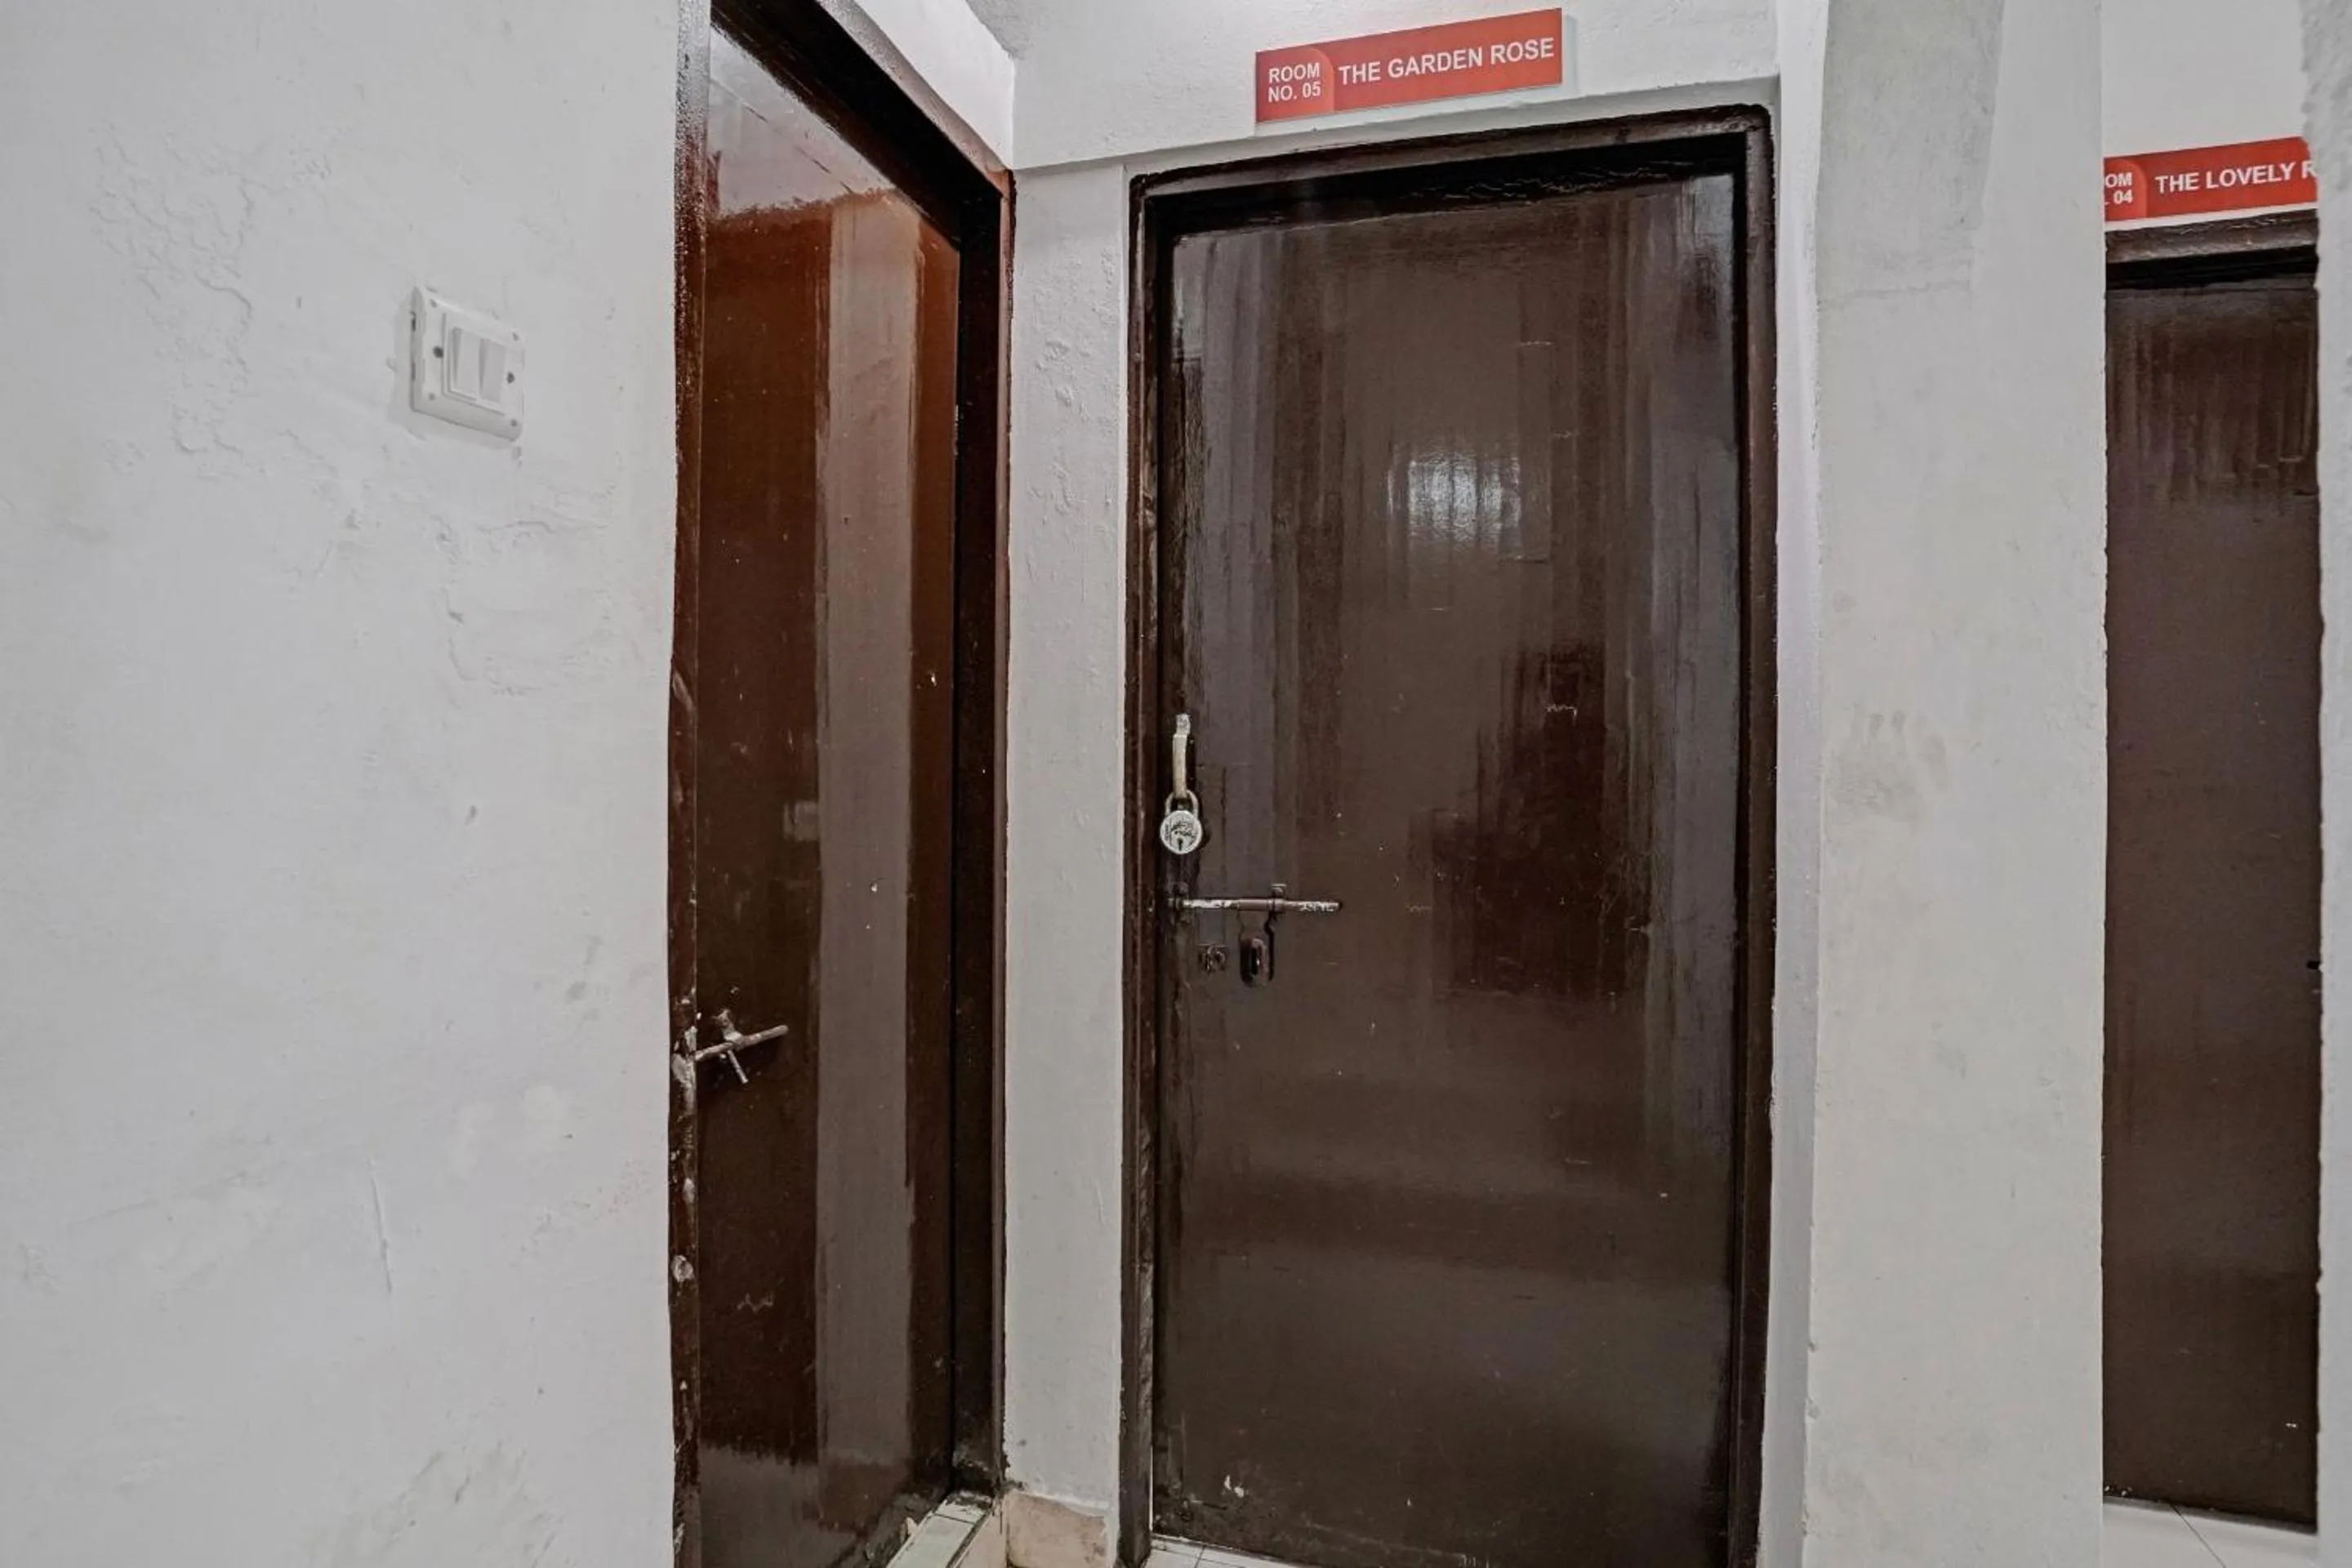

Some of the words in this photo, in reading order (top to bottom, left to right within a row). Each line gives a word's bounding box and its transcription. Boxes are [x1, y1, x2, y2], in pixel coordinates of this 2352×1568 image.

[1339, 61, 1381, 85] THE
[1388, 47, 1483, 76] GARDEN
[1490, 38, 1555, 65] ROSE
[1268, 62, 1321, 83] ROOM
[1268, 85, 1298, 102] NO.
[1302, 81, 1321, 99] 05
[2105, 172, 2133, 188] OM
[2154, 172, 2199, 194] THE
[2206, 161, 2296, 189] LOVELY
[2301, 160, 2317, 178] R
[2114, 189, 2133, 204] 04
